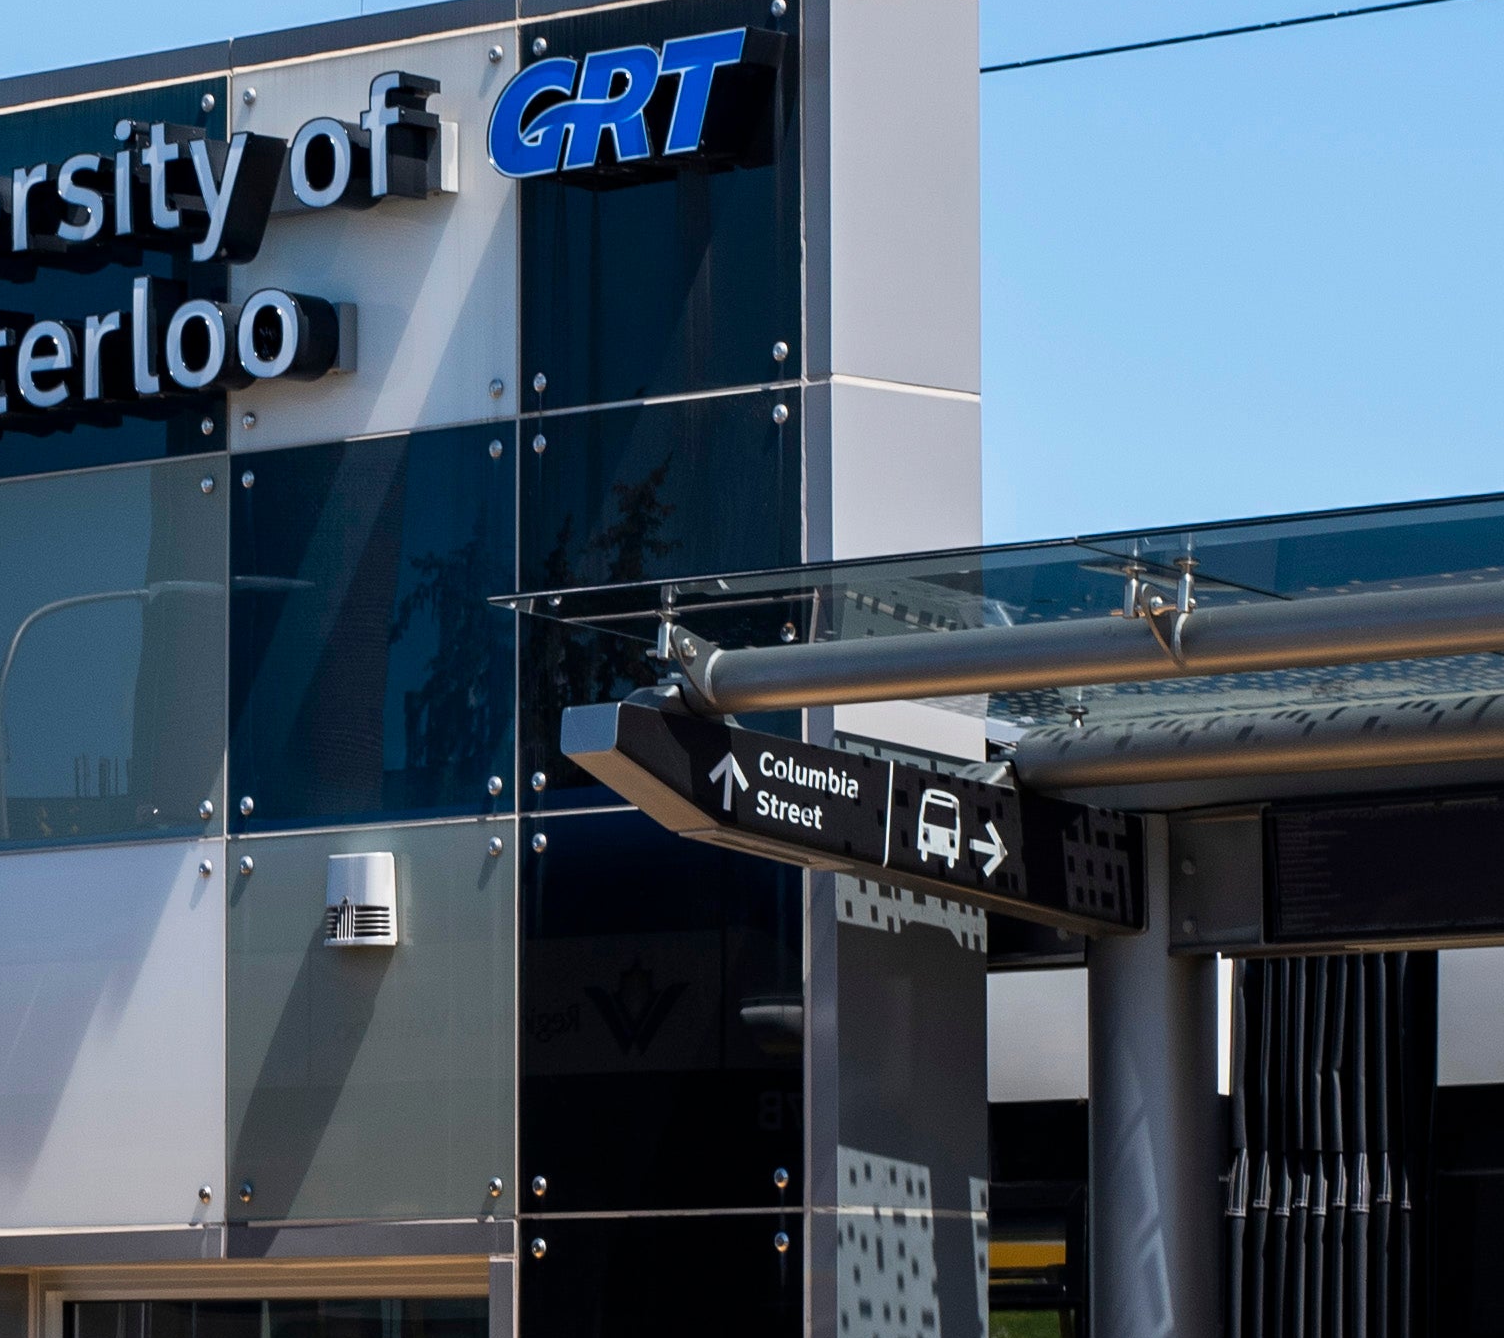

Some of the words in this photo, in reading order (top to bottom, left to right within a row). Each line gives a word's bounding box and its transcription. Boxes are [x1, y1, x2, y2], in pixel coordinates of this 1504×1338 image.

[290, 70, 414, 207] of
[486, 25, 748, 179] GRT
[756, 790, 824, 831] Street
[758, 751, 859, 800] Columbia
